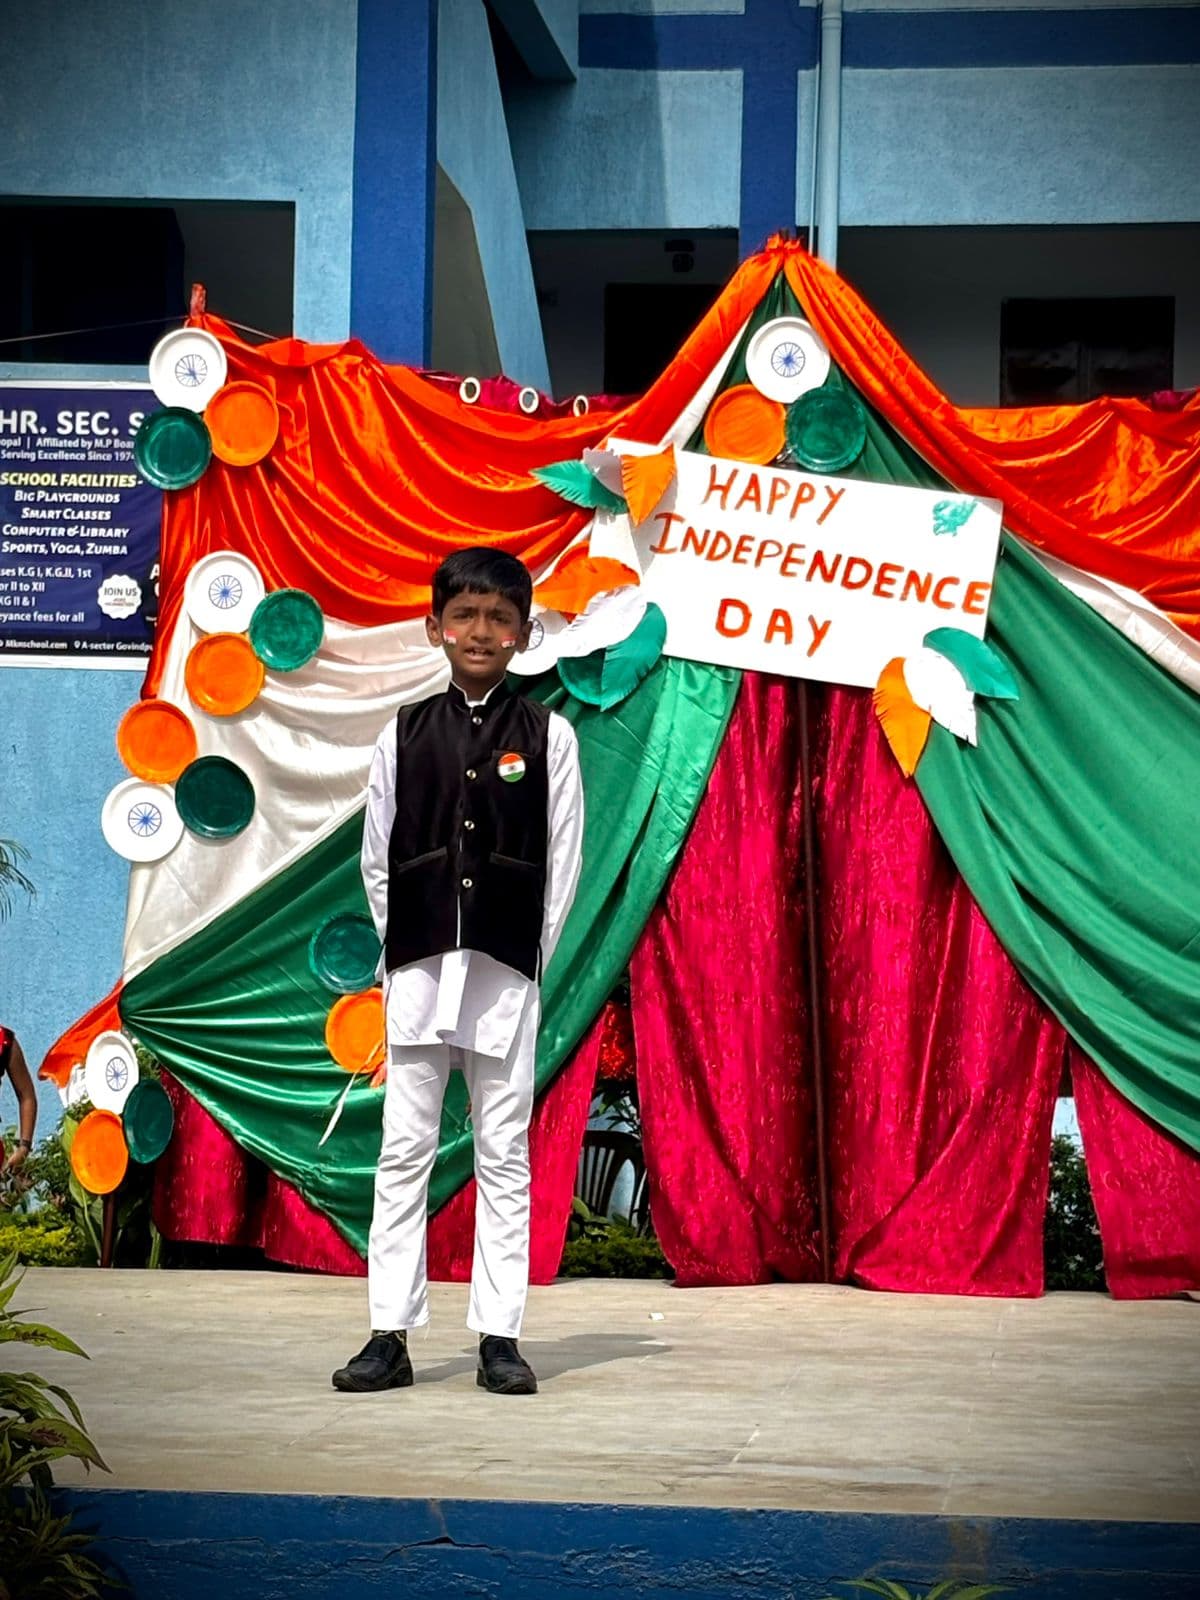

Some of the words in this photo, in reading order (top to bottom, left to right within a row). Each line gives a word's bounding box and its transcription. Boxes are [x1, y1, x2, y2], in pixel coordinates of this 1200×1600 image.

[0, 409, 47, 435] HR.
[57, 411, 119, 436] SEC.
[0, 437, 21, 449] opal
[81, 438, 93, 450] by
[1, 450, 36, 463] Serving
[38, 450, 86, 461] Excellence
[87, 451, 113, 461] Since
[1, 472, 58, 486] SCHOOL
[700, 463, 847, 526] HAPPY
[63, 508, 112, 521] CLASSES
[66, 525, 79, 537] &
[649, 511, 992, 616] INDEPENDENCE
[77, 567, 92, 578] 1st
[19, 582, 30, 592] to
[104, 587, 123, 596] JOIN
[125, 587, 138, 597] US
[21, 596, 30, 607] &
[33, 611, 54, 622] fees
[55, 611, 70, 623] for
[71, 612, 85, 623] all
[714, 598, 833, 658] DAY
